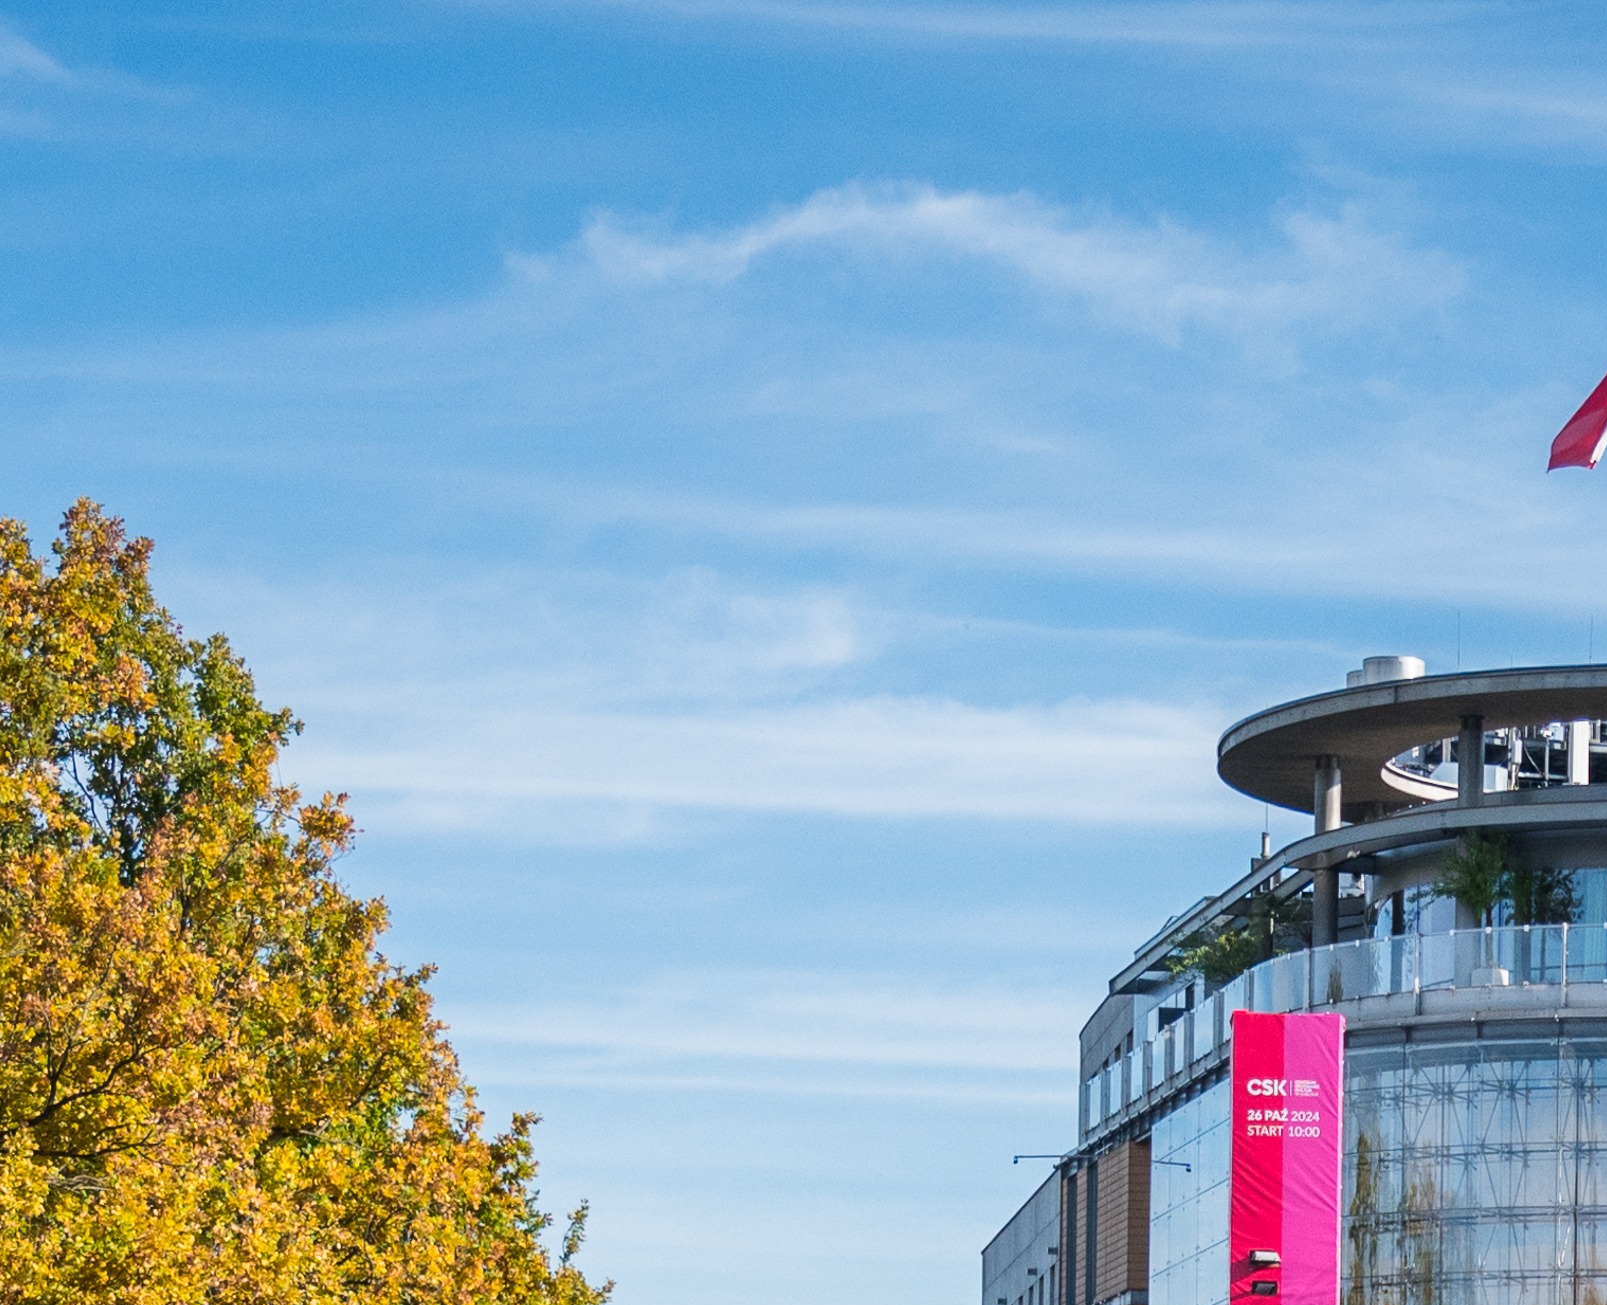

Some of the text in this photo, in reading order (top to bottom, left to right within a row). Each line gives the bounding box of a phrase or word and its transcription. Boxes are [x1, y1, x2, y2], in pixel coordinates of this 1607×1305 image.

[1247, 1079, 1287, 1096] CSK
[1247, 1108, 1320, 1122] 26 PAŹ 2024
[1247, 1125, 1320, 1137] START 10:00
